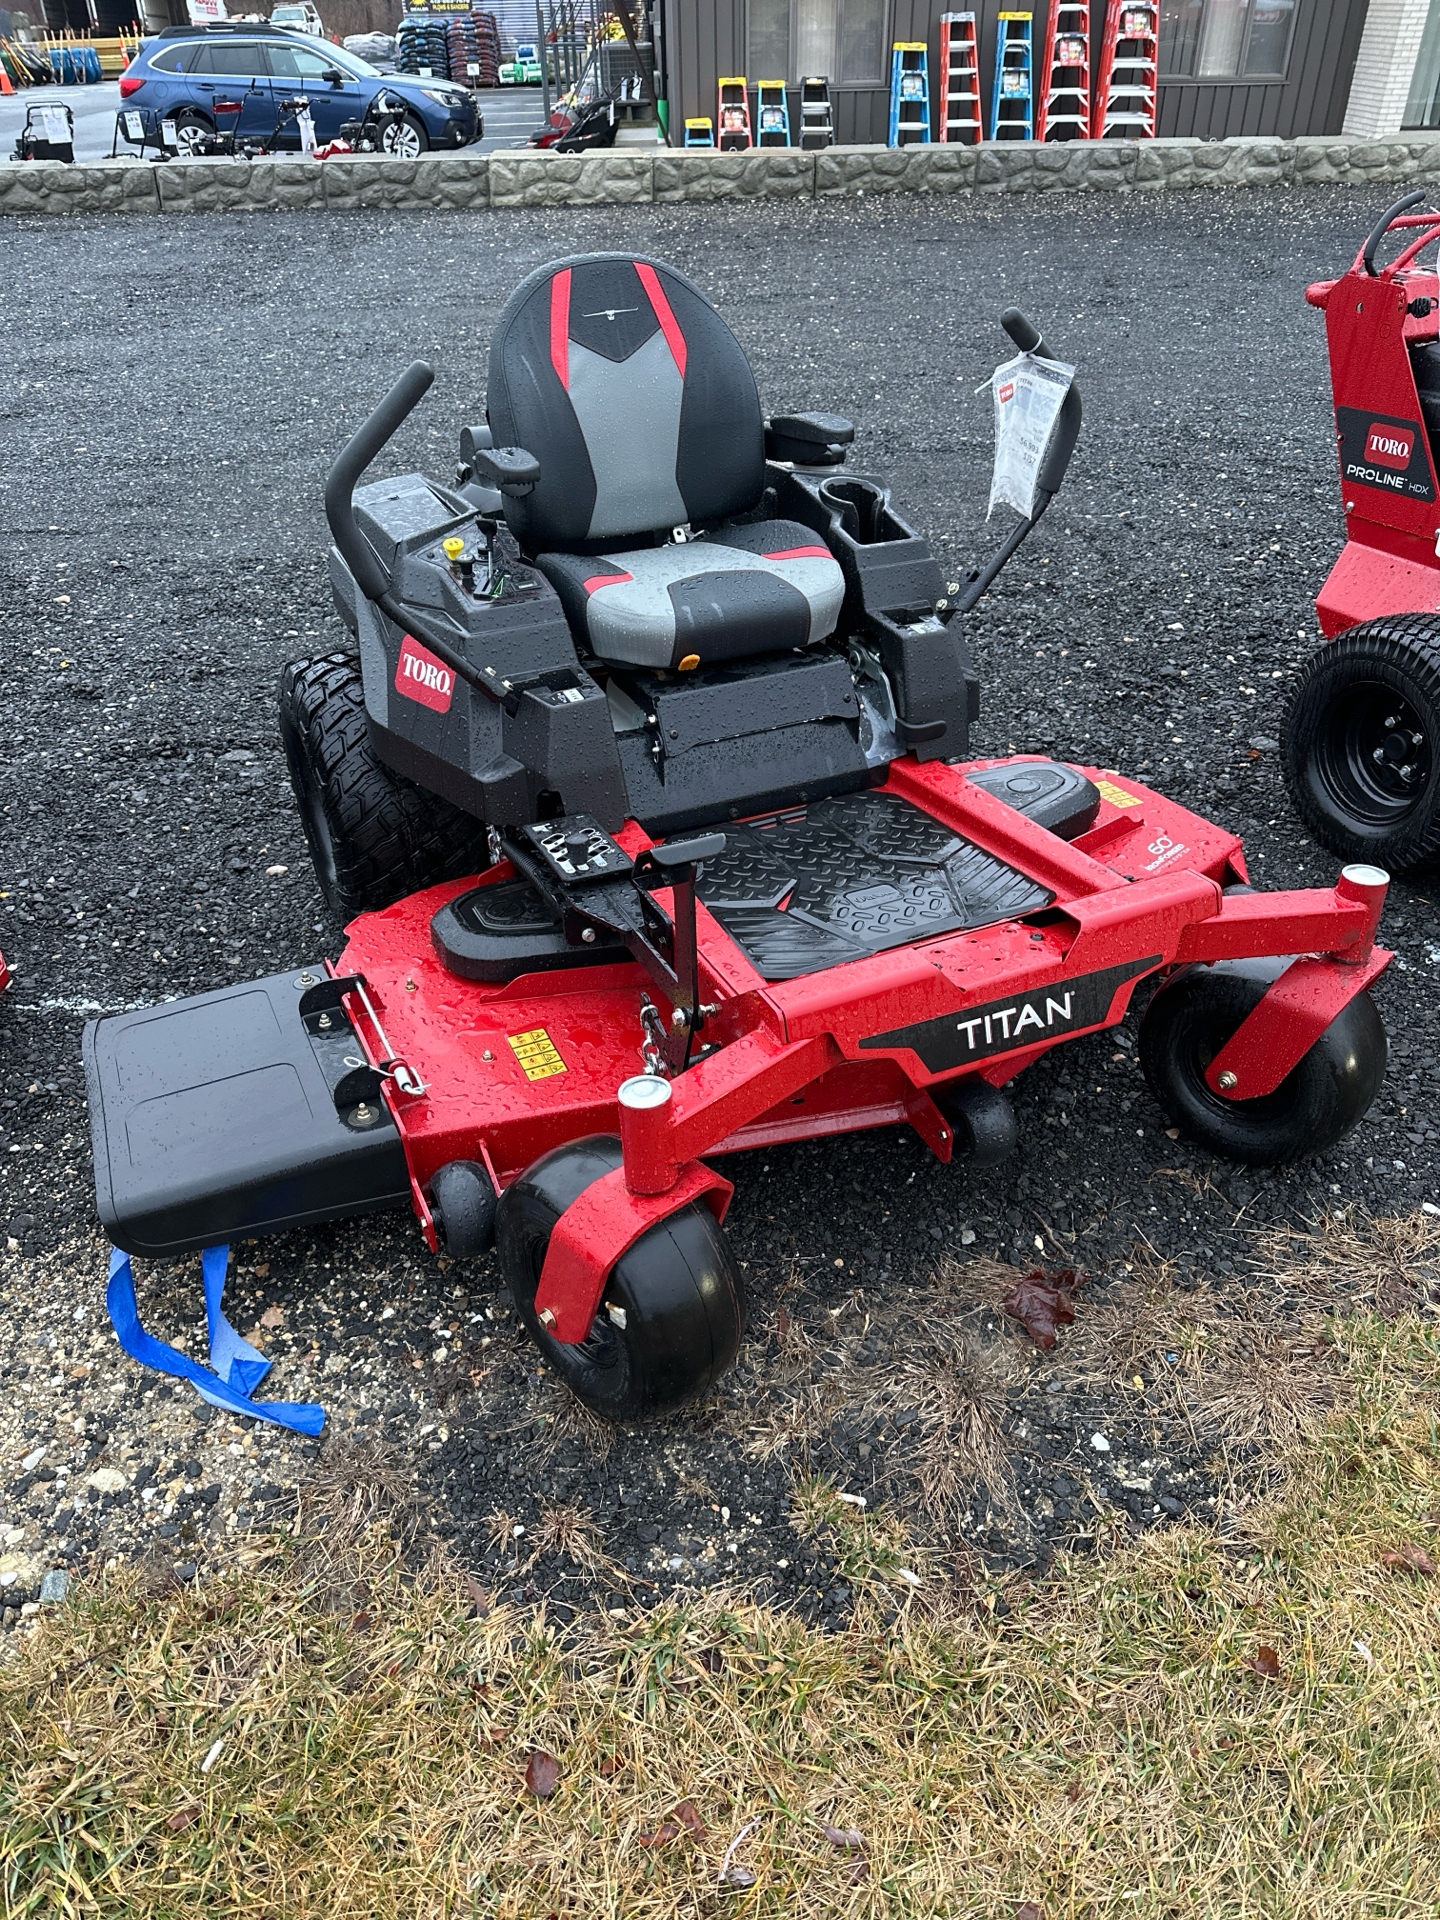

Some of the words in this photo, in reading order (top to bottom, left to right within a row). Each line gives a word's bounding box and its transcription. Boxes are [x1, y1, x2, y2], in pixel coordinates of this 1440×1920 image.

[1370, 435, 1409, 457] TORO
[1346, 464, 1404, 489] PROLINE
[1408, 482, 1430, 495] HDX
[403, 652, 450, 693] TORO
[957, 991, 1072, 1050] TITAN
